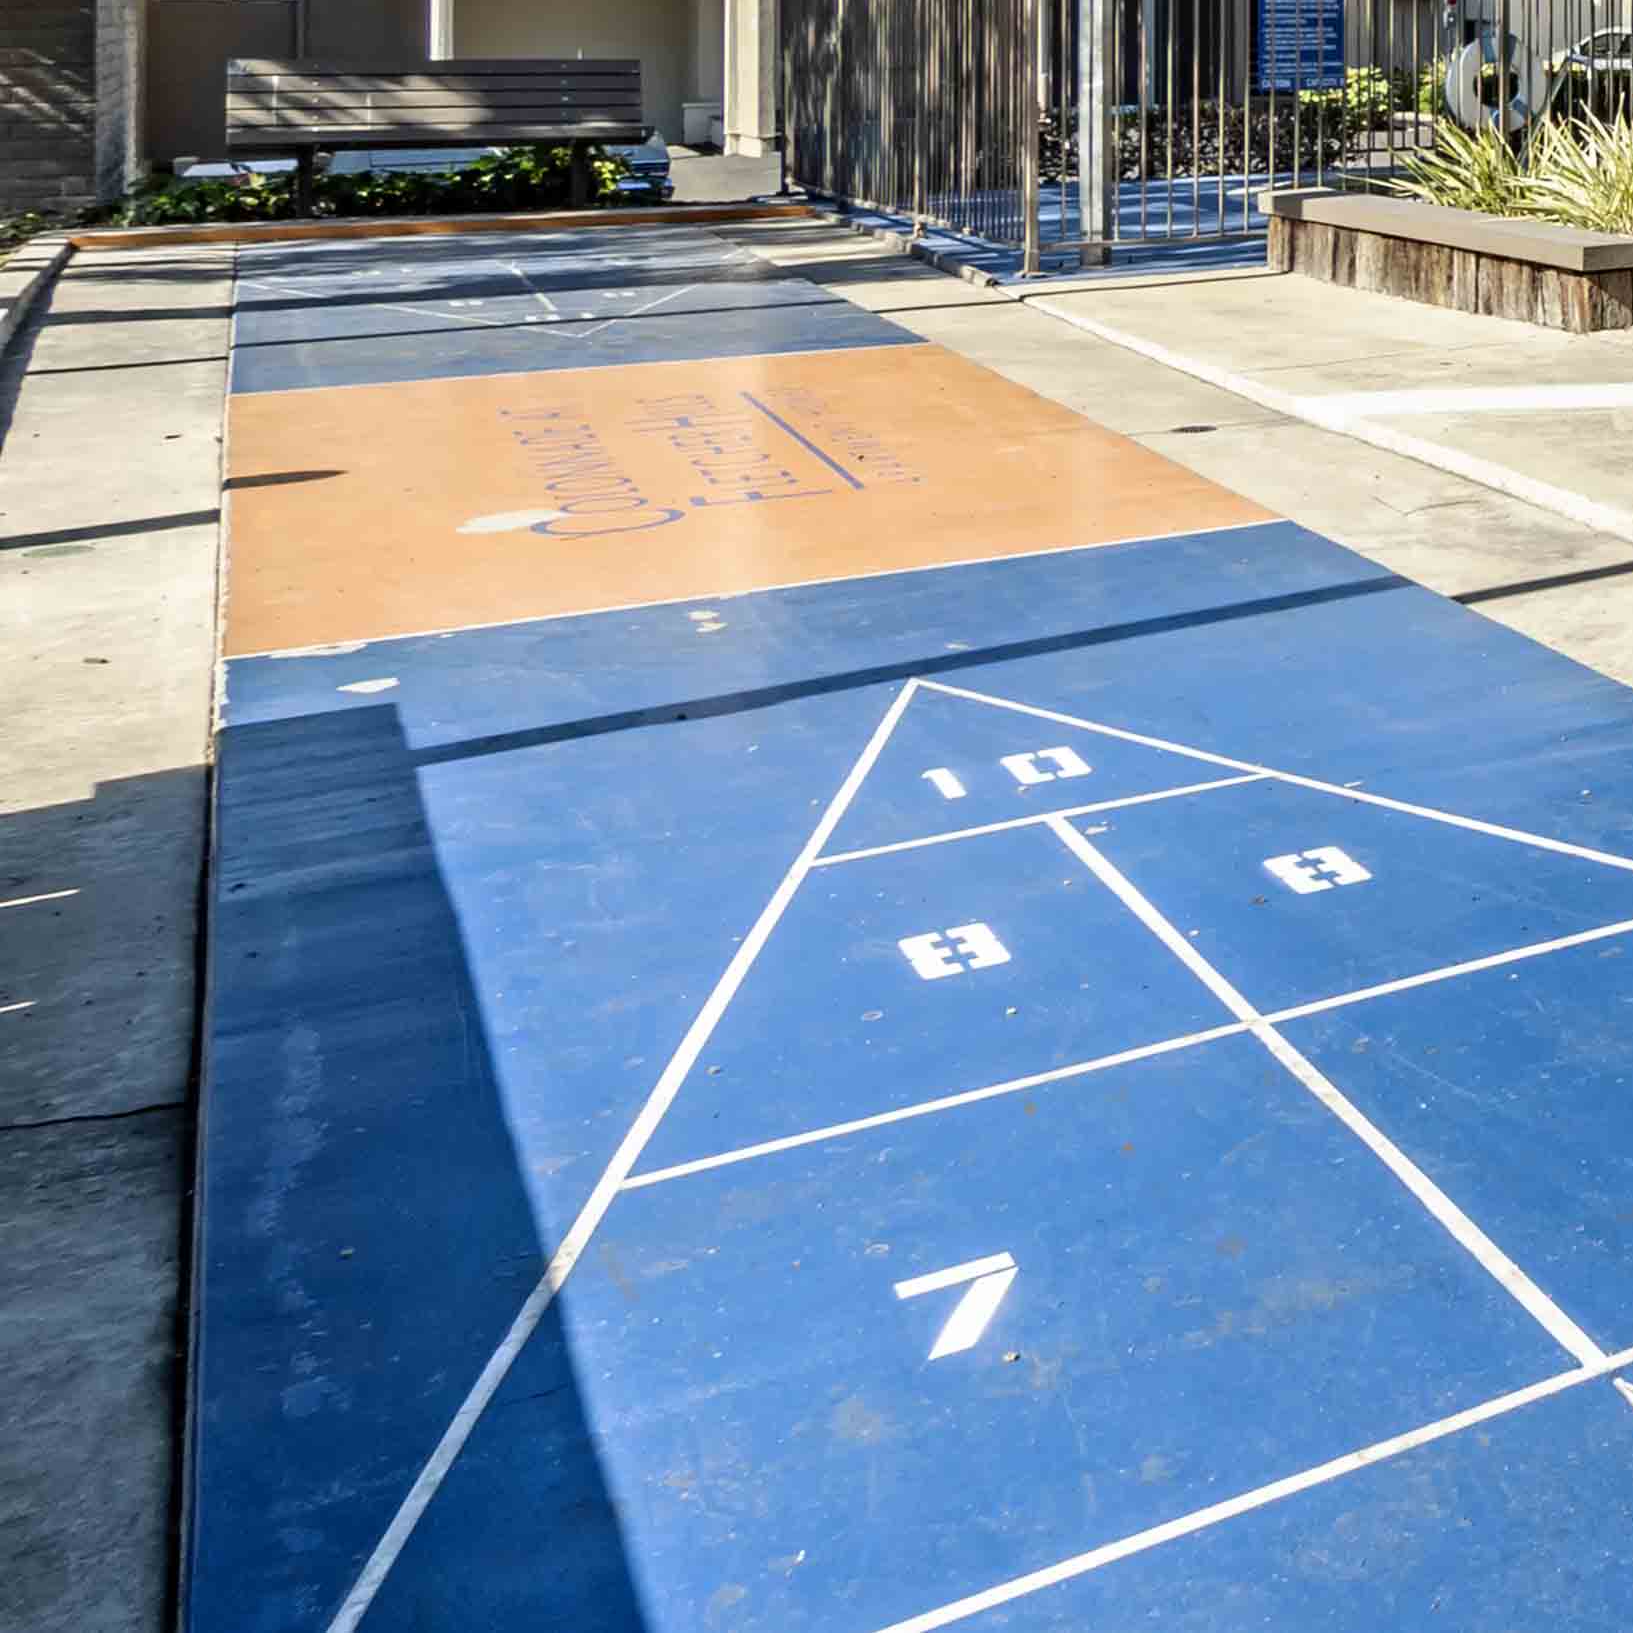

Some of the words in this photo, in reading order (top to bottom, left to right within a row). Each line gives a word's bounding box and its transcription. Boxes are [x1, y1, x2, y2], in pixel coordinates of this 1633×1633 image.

[923, 747, 1091, 800] 10
[1264, 847, 1371, 894] 8
[898, 923, 1011, 979] 8
[894, 1252, 1019, 1360] 7
